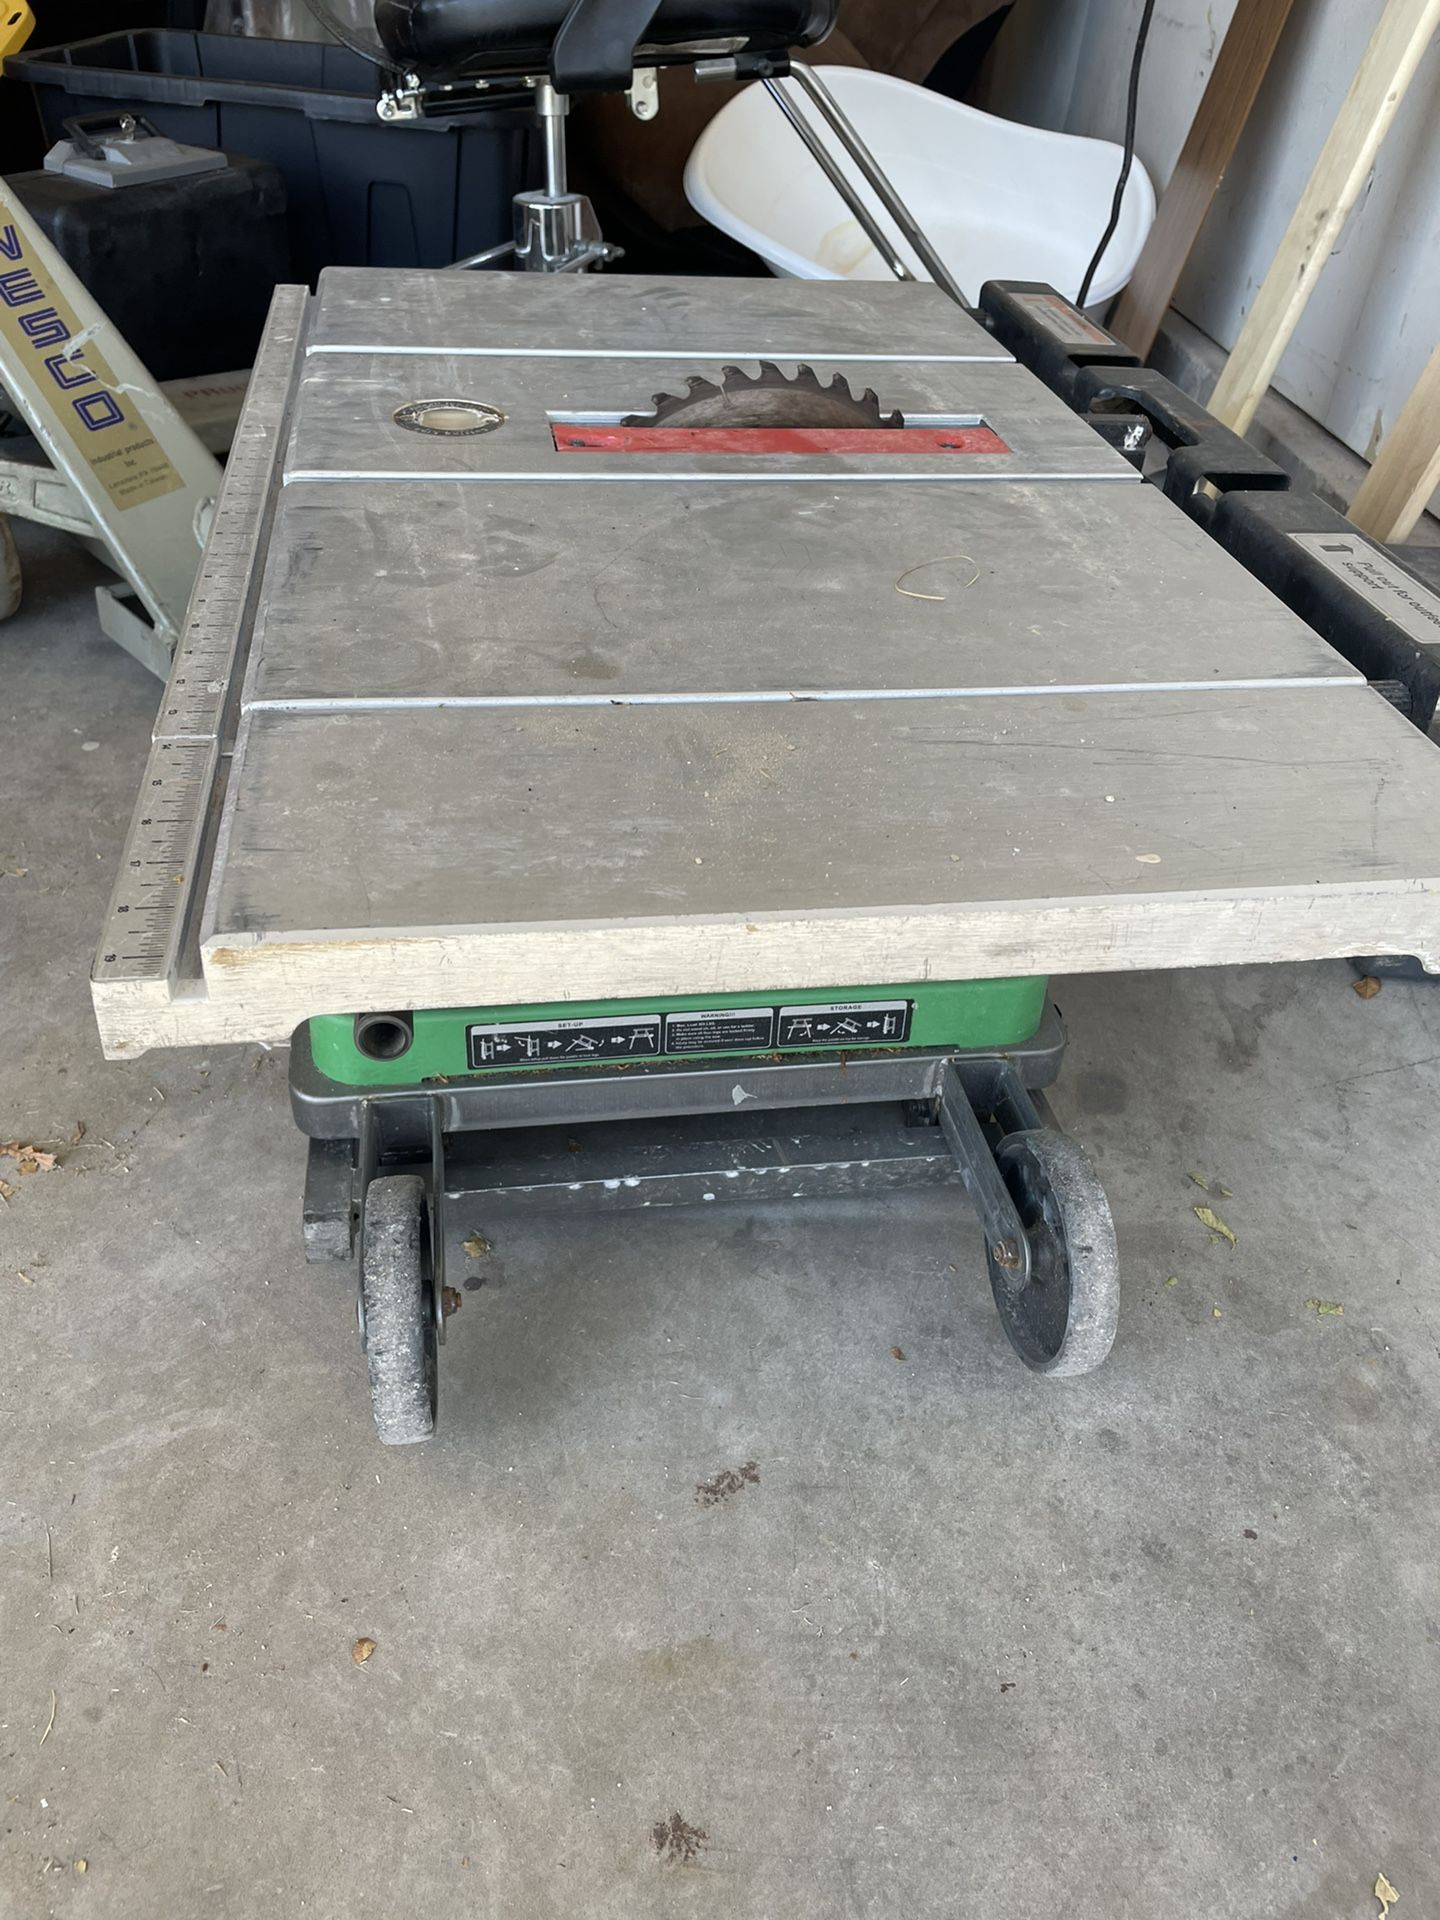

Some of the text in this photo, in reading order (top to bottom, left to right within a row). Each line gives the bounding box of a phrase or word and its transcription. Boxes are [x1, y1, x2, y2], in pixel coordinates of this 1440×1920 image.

[1342, 562, 1384, 589] support
[1376, 576, 1400, 588] out
[1393, 589, 1414, 601] for
[117, 905, 130, 913] 18
[104, 953, 117, 963] 19
